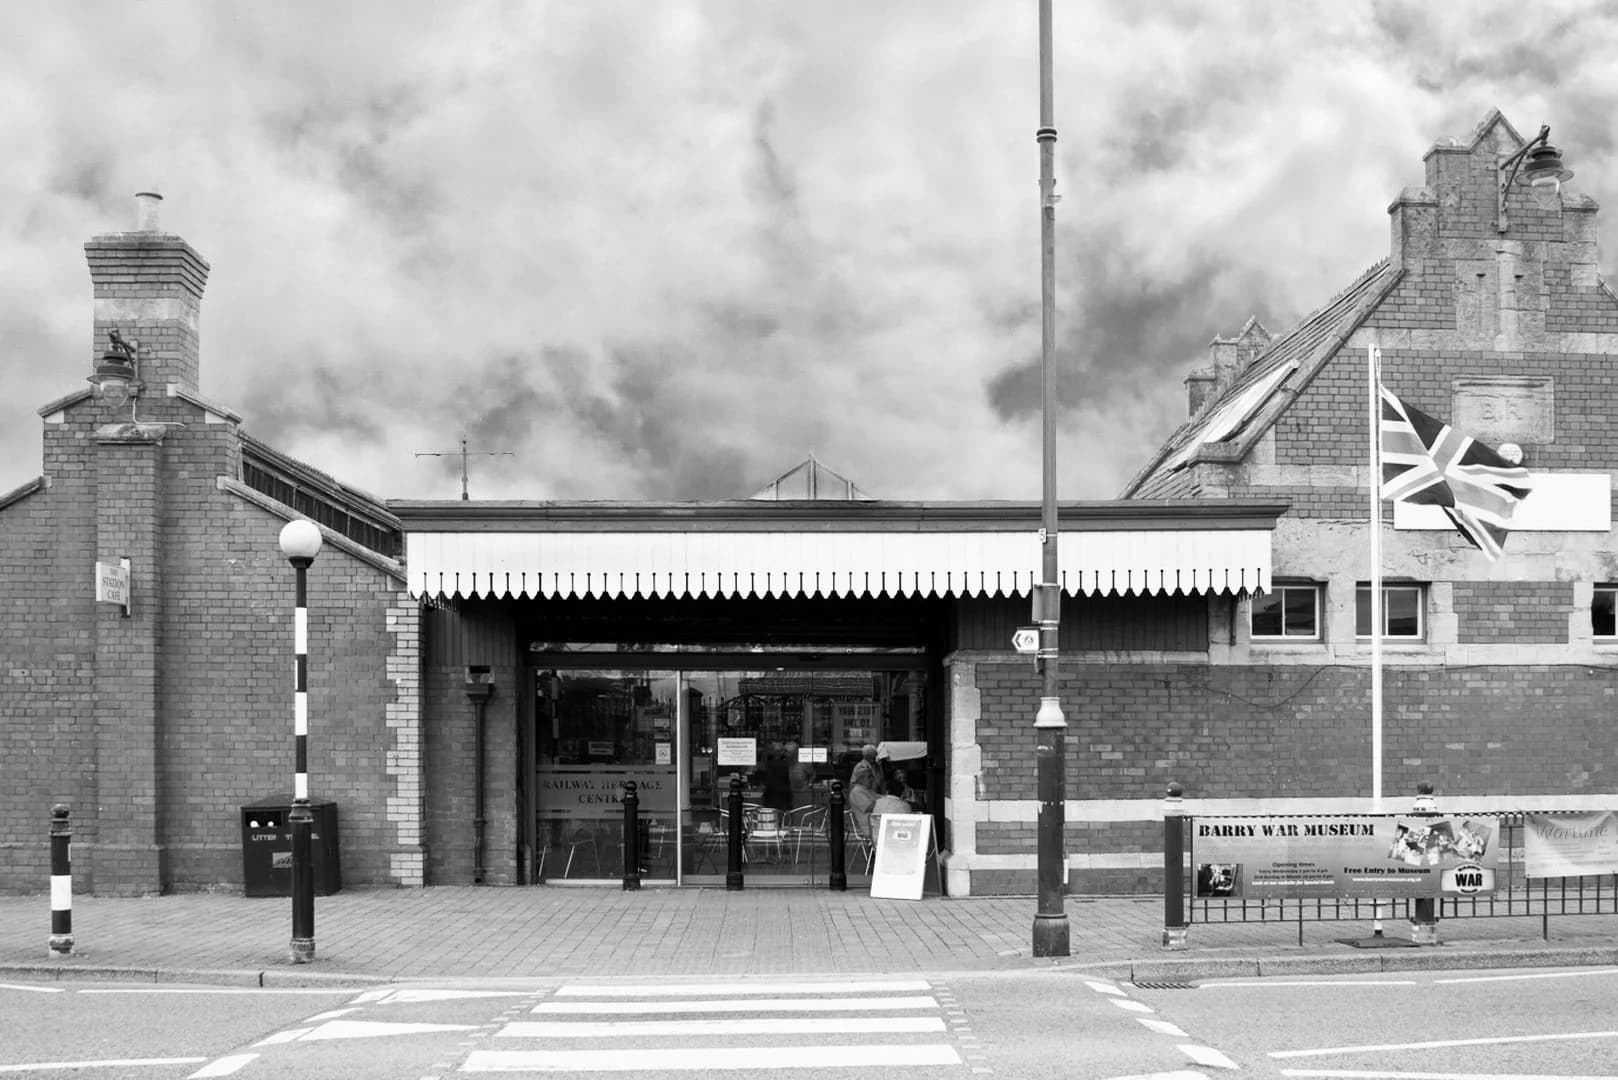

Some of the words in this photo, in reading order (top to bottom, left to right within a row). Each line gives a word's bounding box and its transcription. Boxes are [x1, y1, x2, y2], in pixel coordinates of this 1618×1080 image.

[103, 576, 125, 589] STATION
[543, 780, 595, 790] RAILWAY
[579, 794, 624, 804] CENTR
[1199, 824, 1257, 837] BARRY
[1261, 824, 1300, 837] WAR
[1303, 823, 1375, 837] MUSEUM
[1364, 867, 1385, 875] Entry
[1398, 866, 1432, 874] Museum
[1455, 873, 1483, 887] WAR
